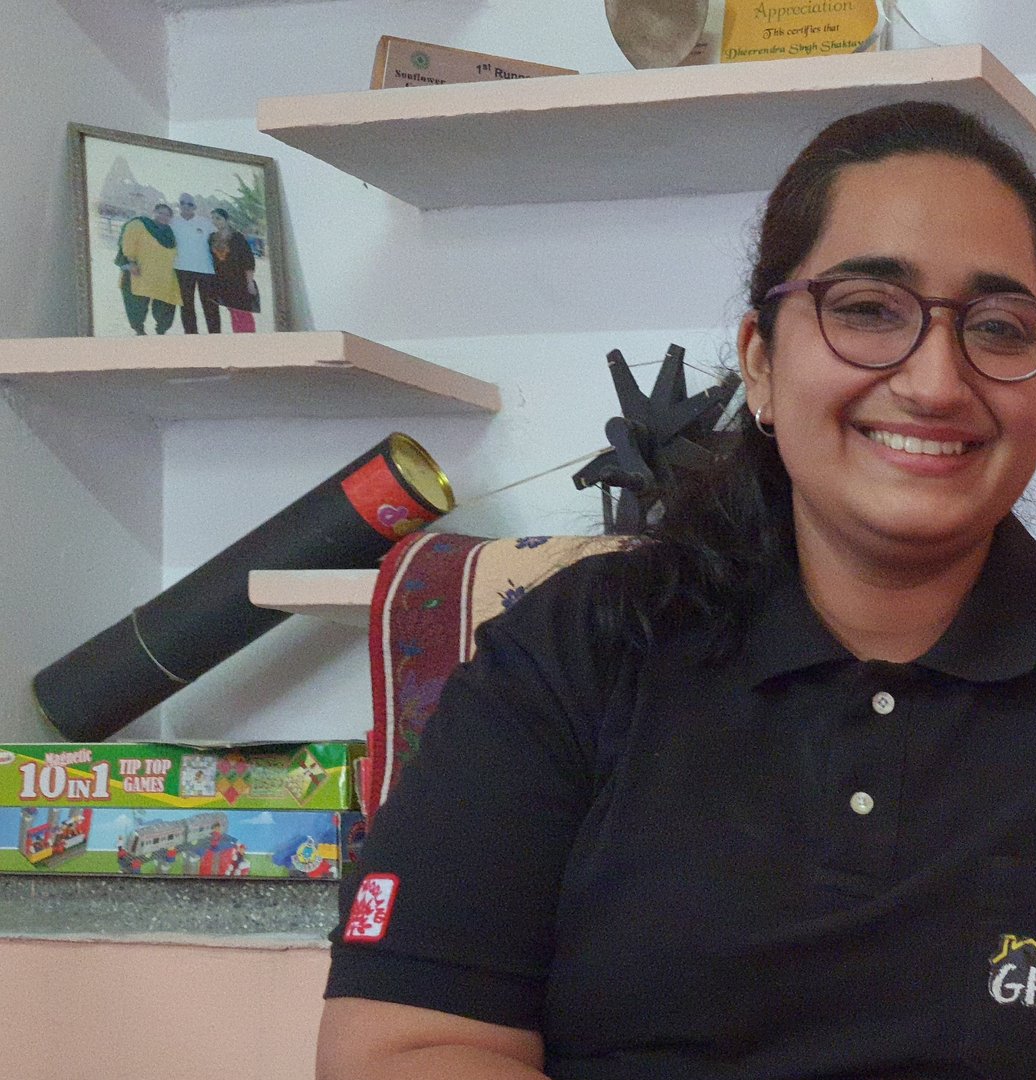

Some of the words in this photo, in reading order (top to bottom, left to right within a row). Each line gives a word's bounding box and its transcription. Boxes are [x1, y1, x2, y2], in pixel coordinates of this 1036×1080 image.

[755, 0, 854, 22] Appreciation
[763, 28, 784, 39] This
[787, 26, 821, 37] certifies
[823, 24, 840, 33] that
[788, 43, 818, 55] Singh
[476, 63, 491, 75] 1st
[394, 69, 447, 86] Sunflower
[119, 759, 142, 775] TIP
[144, 759, 172, 775] TOP
[123, 776, 165, 793] GAMES
